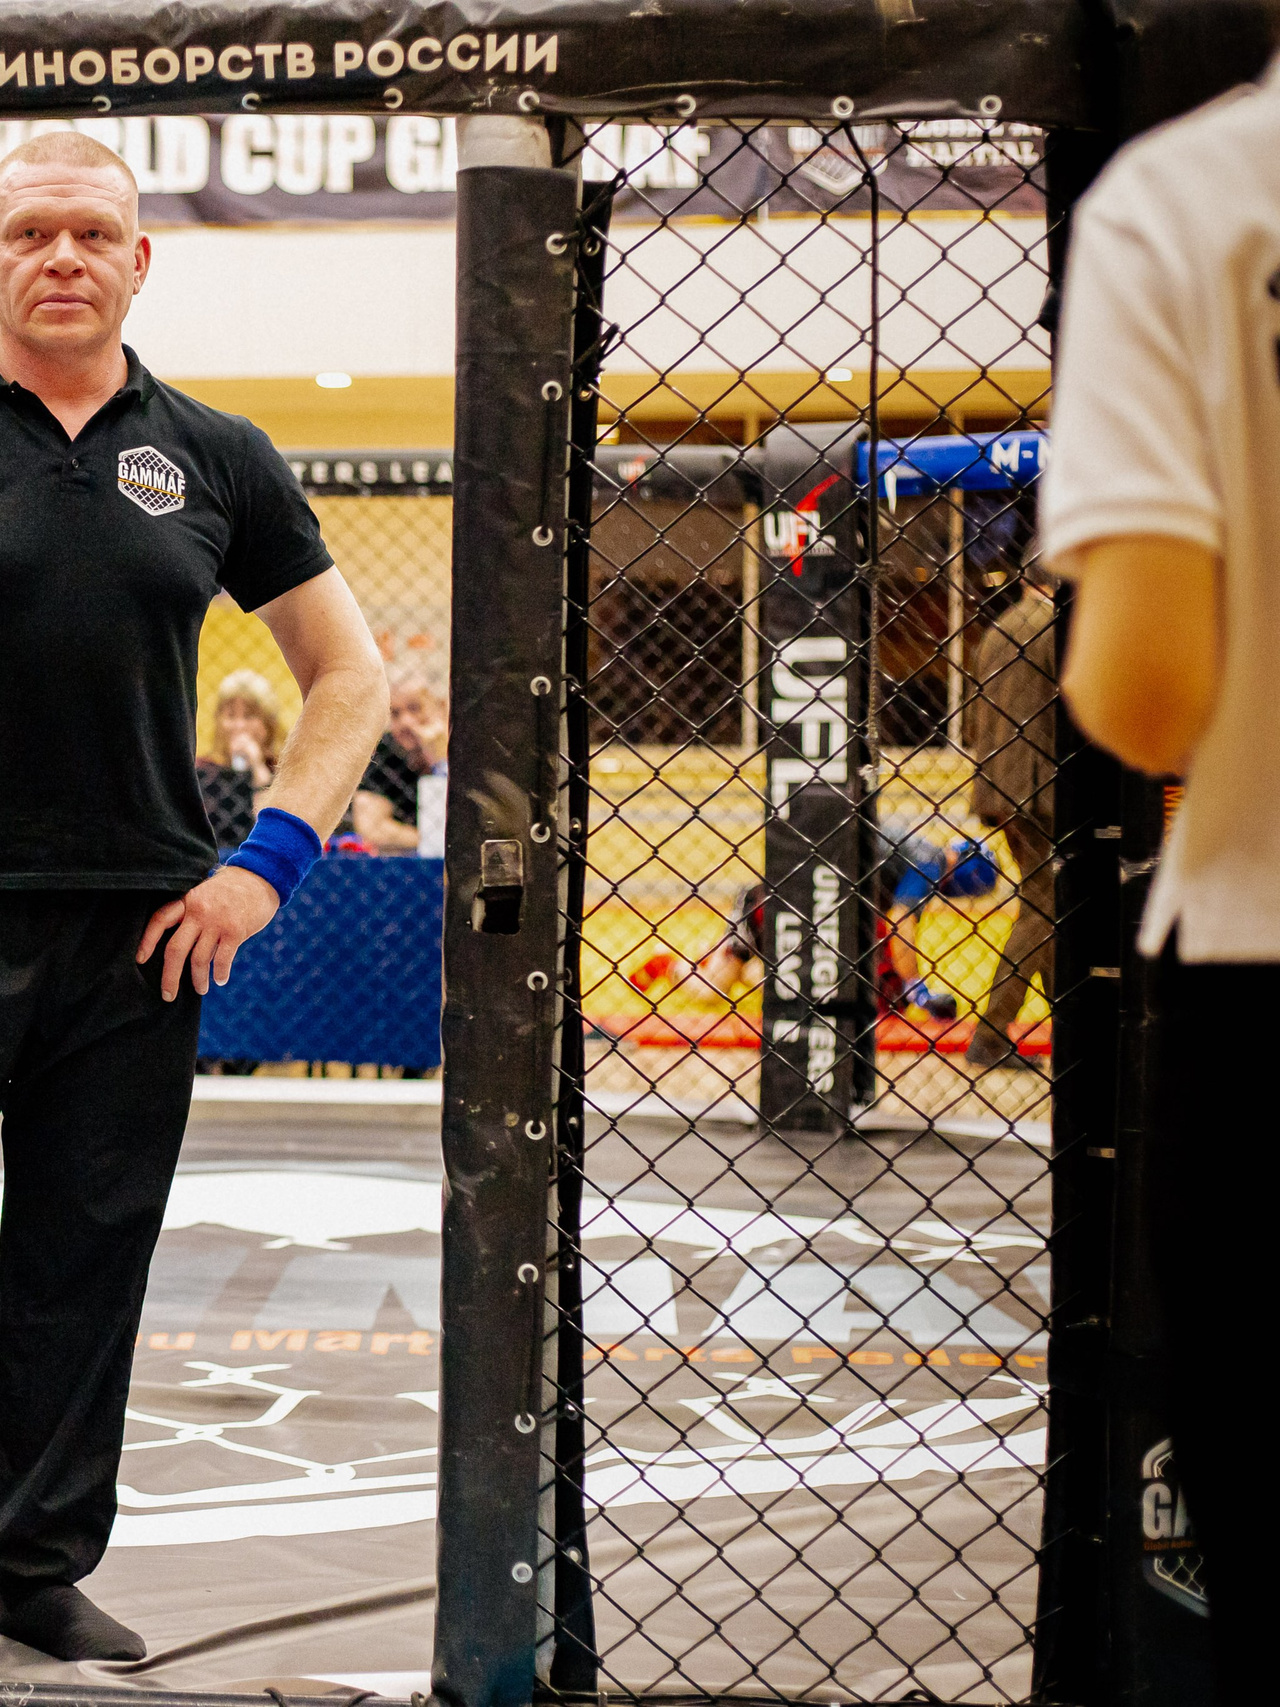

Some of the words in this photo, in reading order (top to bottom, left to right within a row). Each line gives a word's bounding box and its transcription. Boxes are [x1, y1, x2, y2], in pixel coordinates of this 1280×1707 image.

[334, 33, 559, 79] РОССИИ
[221, 115, 377, 195] CUP
[118, 461, 186, 497] GAMMAF
[389, 461, 454, 484] LEA
[763, 510, 837, 550] UFL
[771, 636, 848, 821] UFL
[772, 911, 803, 1044] LEAGE
[230, 1330, 436, 1355] Mart
